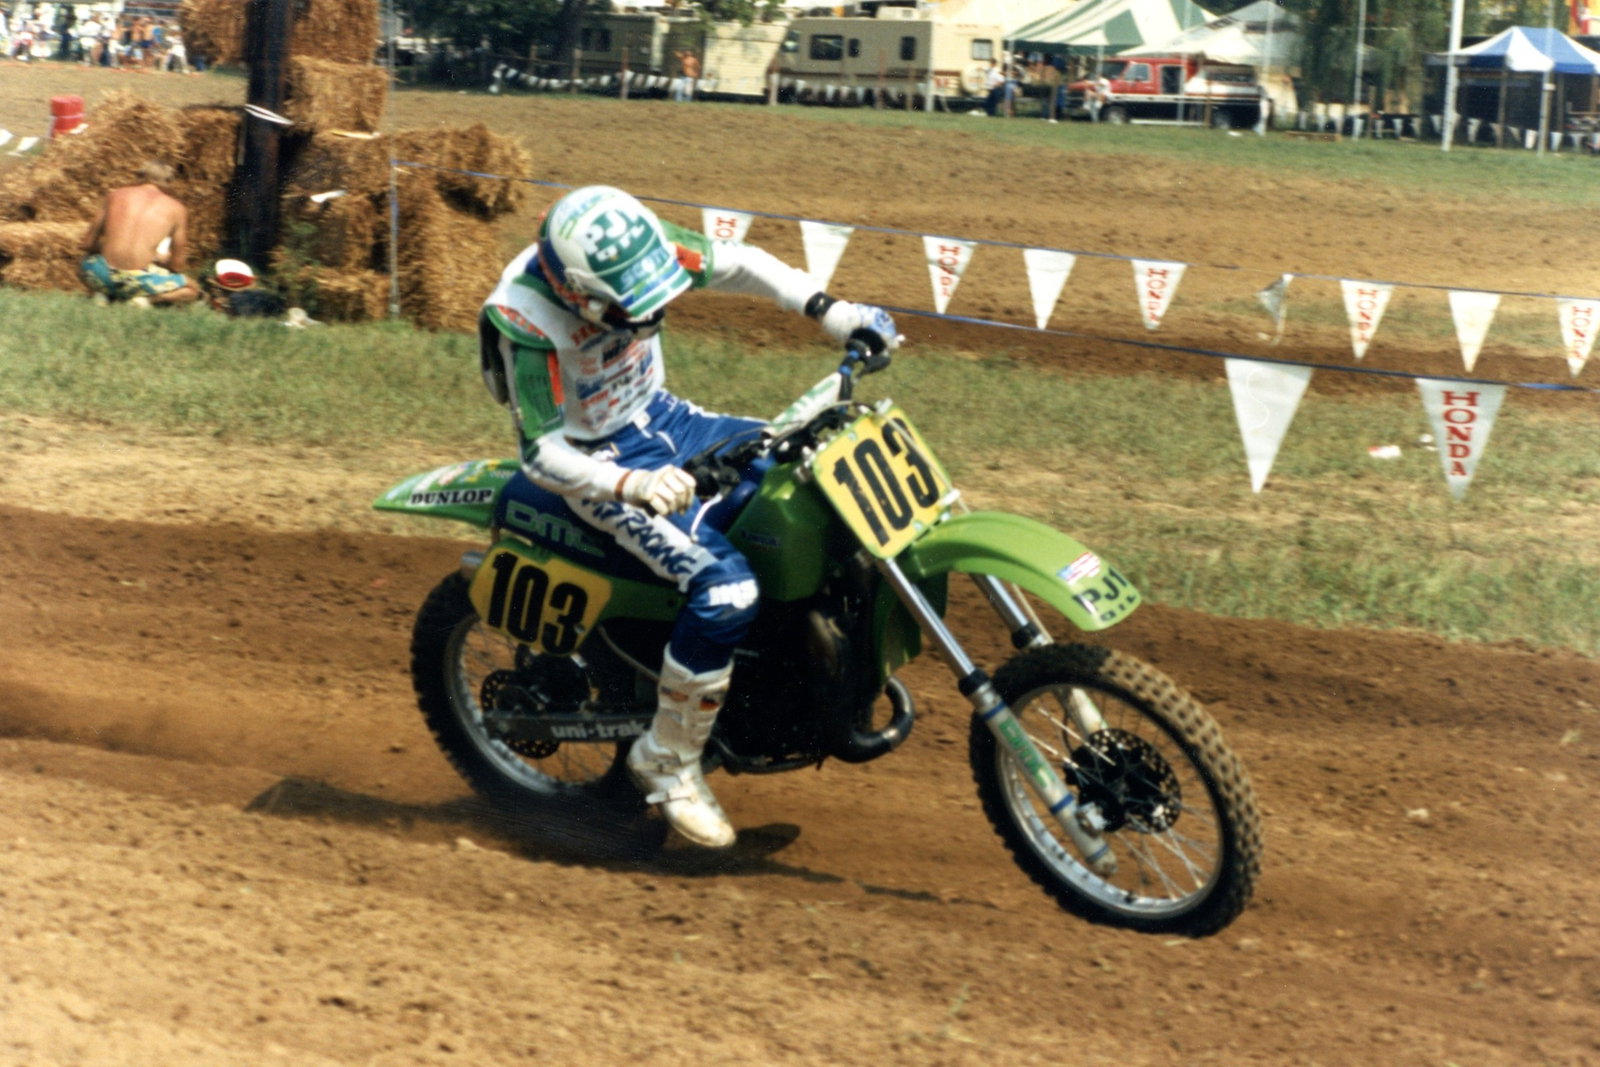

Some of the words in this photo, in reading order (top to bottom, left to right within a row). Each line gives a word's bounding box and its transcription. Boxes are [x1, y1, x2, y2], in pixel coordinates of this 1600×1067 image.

[1441, 391, 1480, 477] HONDA
[411, 489, 493, 505] DUNLOP
[833, 417, 940, 547] 103
[616, 510, 697, 576] RACING
[487, 552, 588, 657] 103
